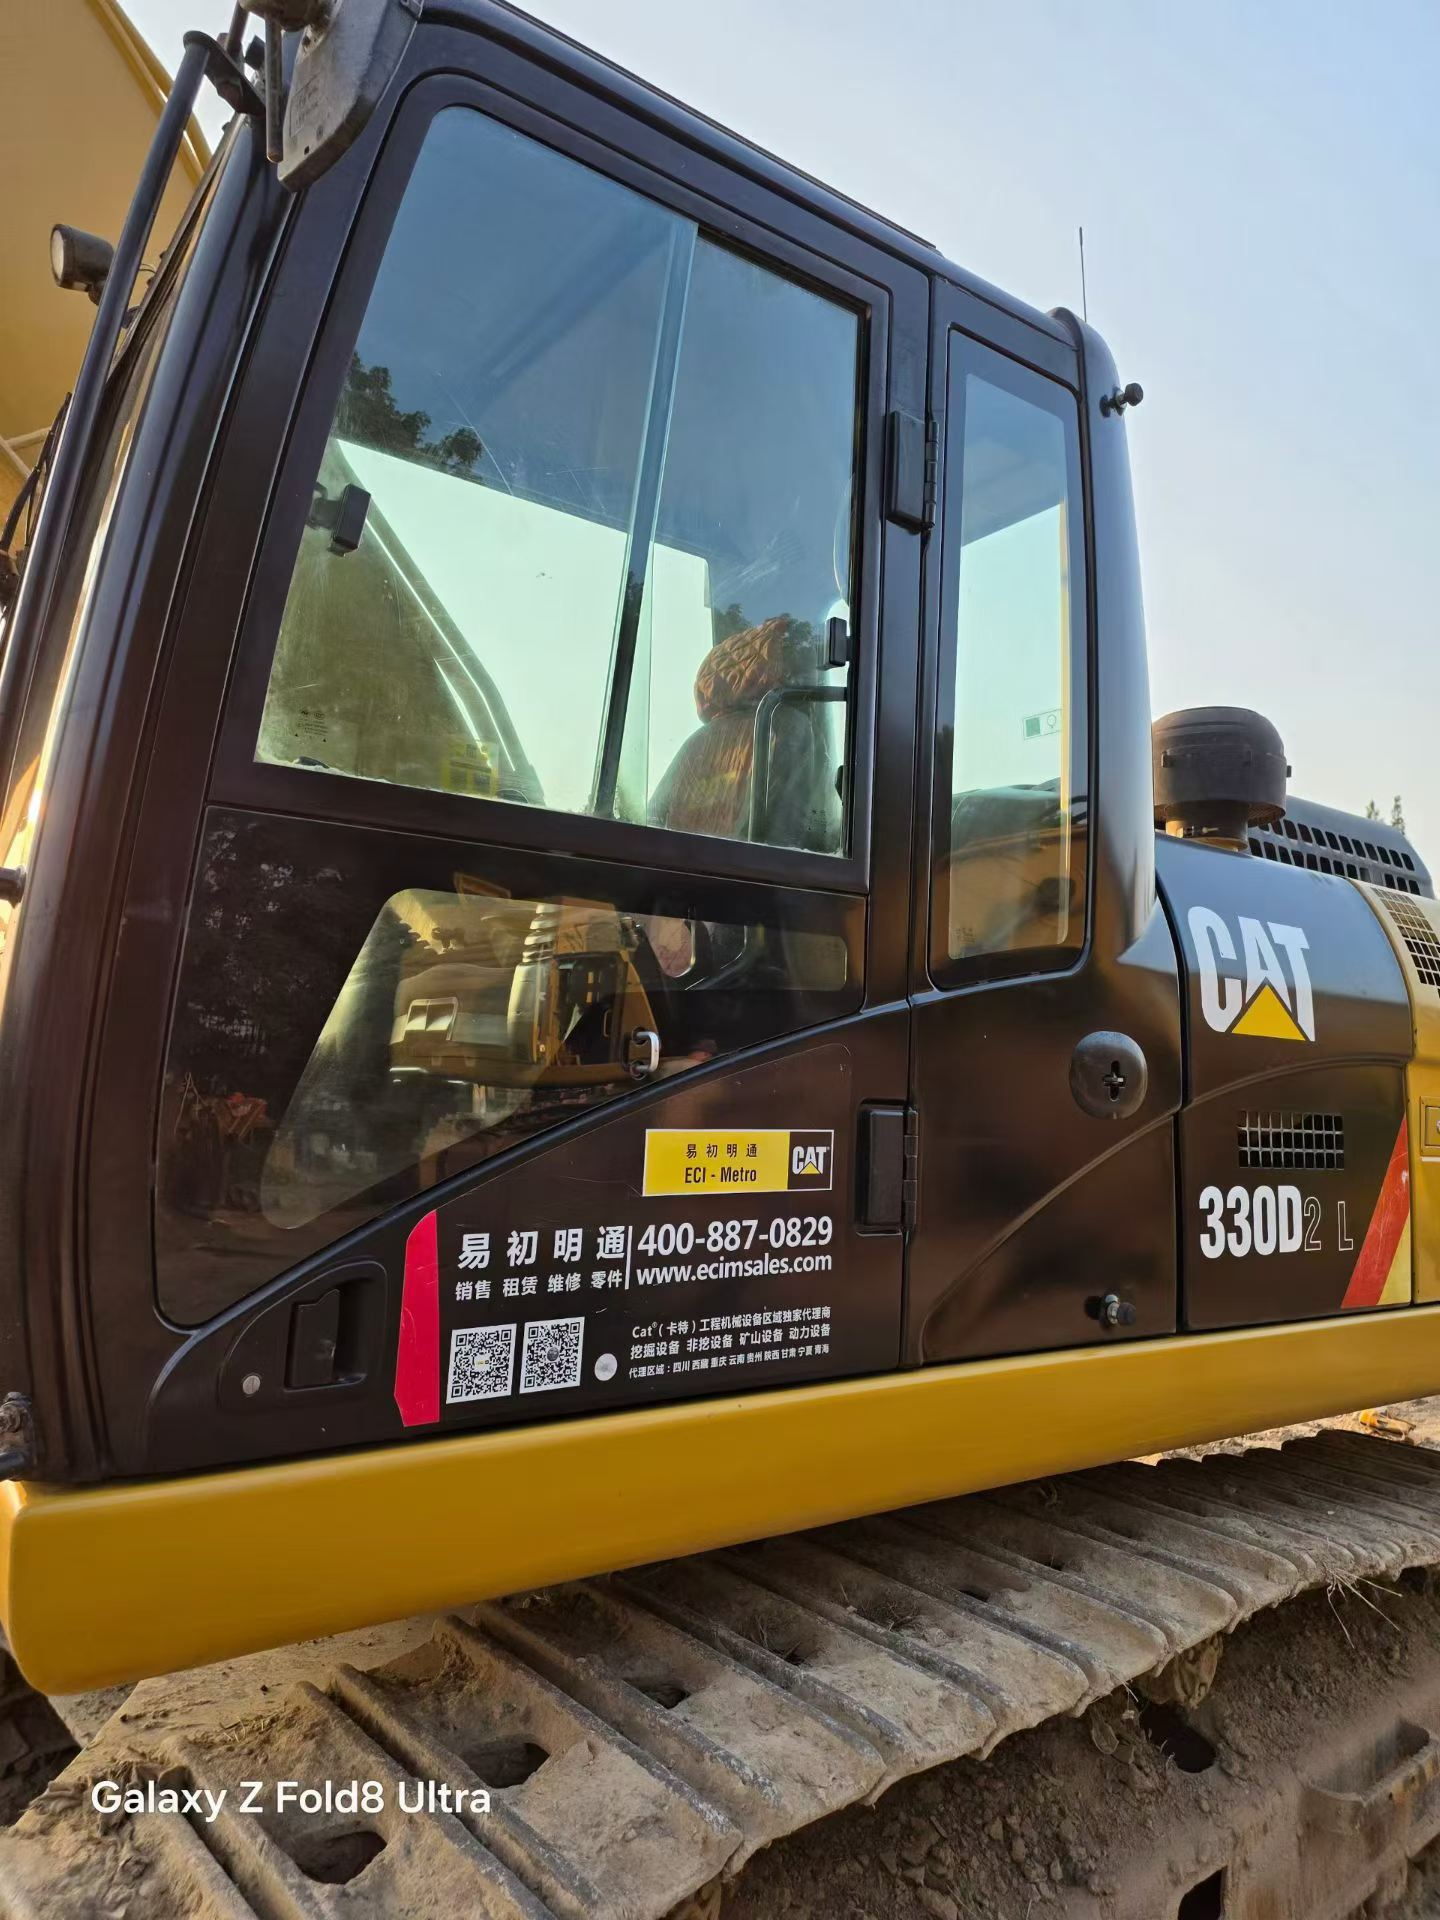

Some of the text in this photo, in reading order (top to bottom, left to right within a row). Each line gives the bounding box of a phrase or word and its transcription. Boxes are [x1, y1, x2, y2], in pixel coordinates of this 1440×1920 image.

[1188, 905, 1315, 1042] CAT
[686, 1144, 757, 1158] 易初明通
[685, 1167, 706, 1183] ECI
[720, 1167, 757, 1182] Metro
[637, 1215, 833, 1257] 400-887-0829
[1337, 1201, 1354, 1252] L
[457, 1225, 626, 1269] 易初明通
[455, 1269, 623, 1301] 销售 租赁 维修 零件
[636, 1253, 833, 1285] www.ecimsales.com
[630, 1323, 831, 1360] 挖掘设备 非挖设备 矿山设备 动力设备
